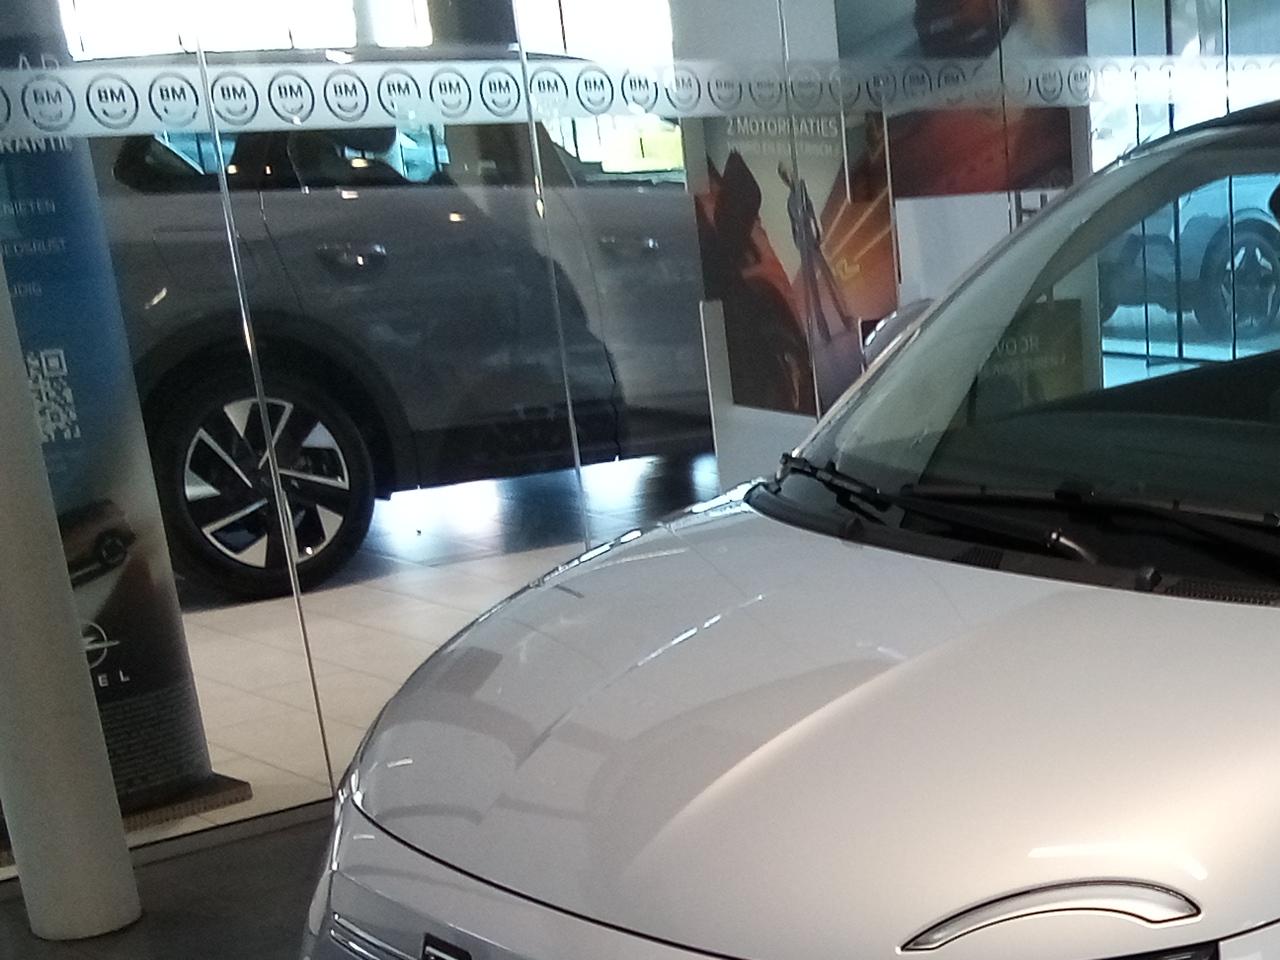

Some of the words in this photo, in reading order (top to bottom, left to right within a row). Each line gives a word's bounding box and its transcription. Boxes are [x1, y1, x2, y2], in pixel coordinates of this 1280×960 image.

[97, 86, 126, 104] BM
[159, 84, 187, 101] BM
[220, 84, 247, 100] BM
[277, 83, 304, 99] BM
[333, 82, 358, 98] BM
[387, 81, 410, 97] BM
[438, 80, 461, 95] BM
[488, 79, 511, 94] BM
[537, 79, 559, 94] BM
[584, 77, 605, 93] BM
